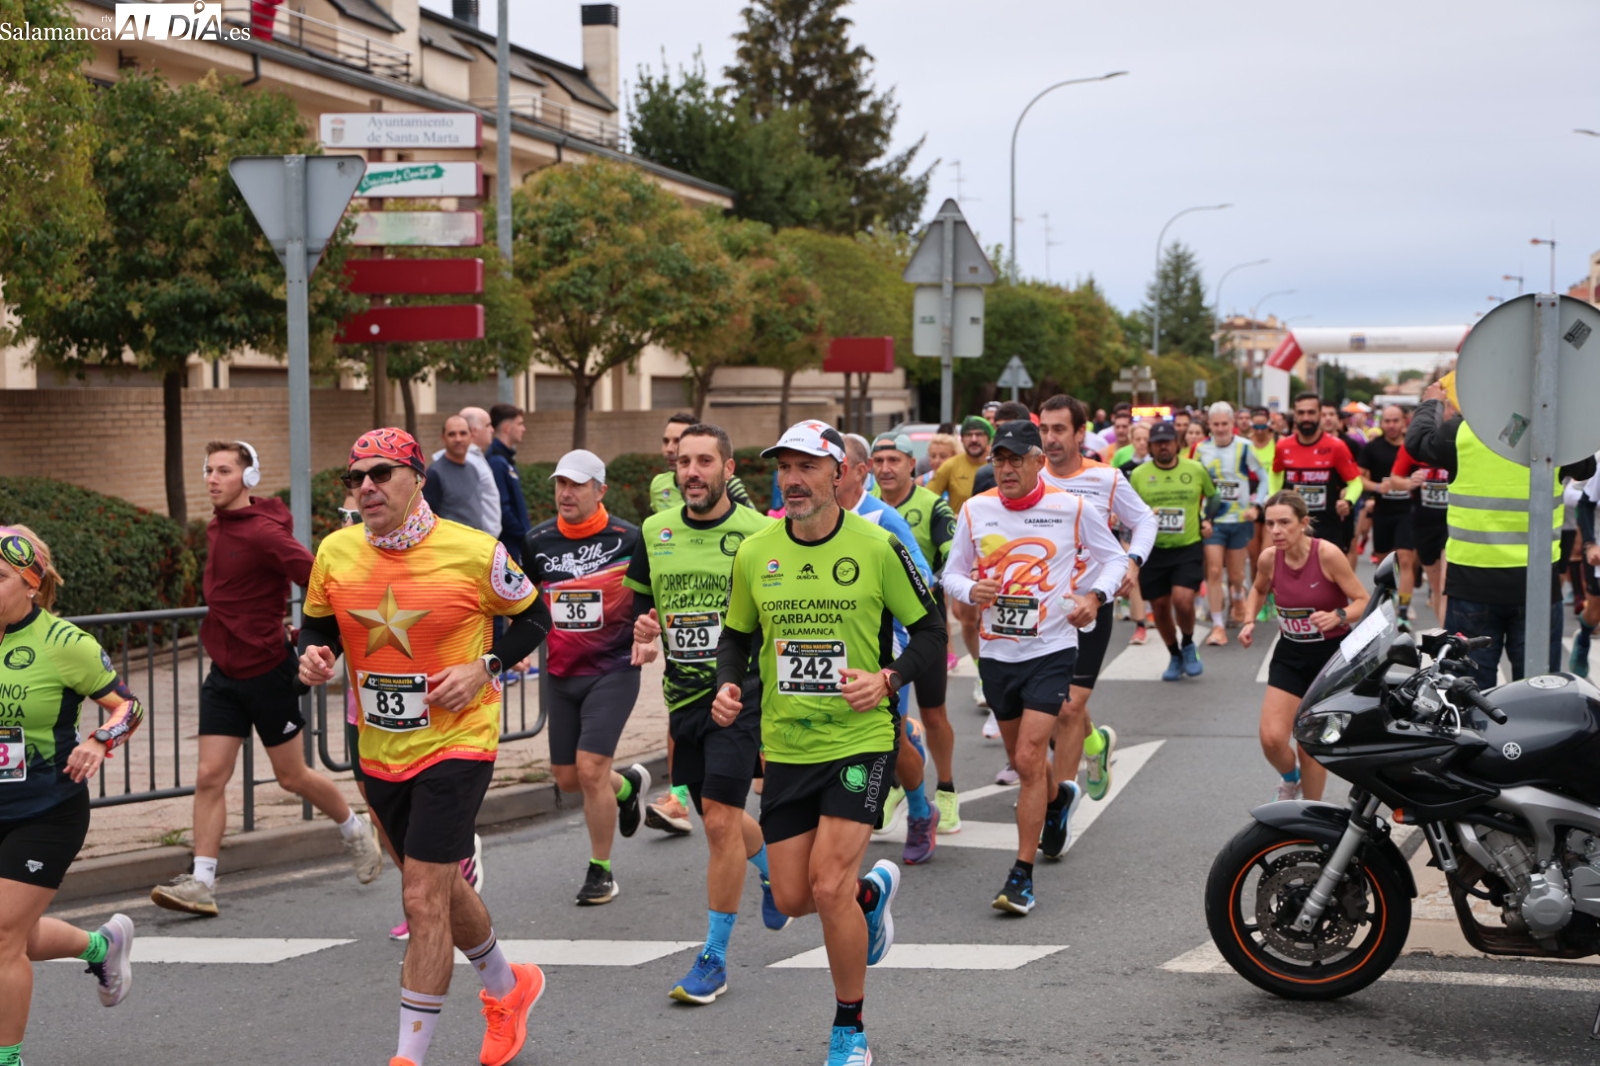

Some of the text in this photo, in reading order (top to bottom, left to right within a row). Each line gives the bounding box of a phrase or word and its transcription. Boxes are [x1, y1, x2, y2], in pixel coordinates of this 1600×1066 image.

[367, 116, 454, 129] Ayuntamiento
[367, 132, 459, 143] de Santa Marta
[1302, 470, 1330, 481] TEAM
[901, 550, 926, 596] CARBAJOSA
[659, 573, 728, 591] ORRECAMINO
[566, 603, 587, 620] 36
[761, 599, 857, 612] CORRECAMINOS
[771, 613, 843, 625] CARBAJOSA
[997, 607, 1028, 626] 327
[782, 628, 835, 636] SALAMANCA
[1284, 618, 1312, 633] 105
[675, 627, 710, 648] 629
[790, 657, 833, 679] 242
[376, 690, 405, 716] 83
